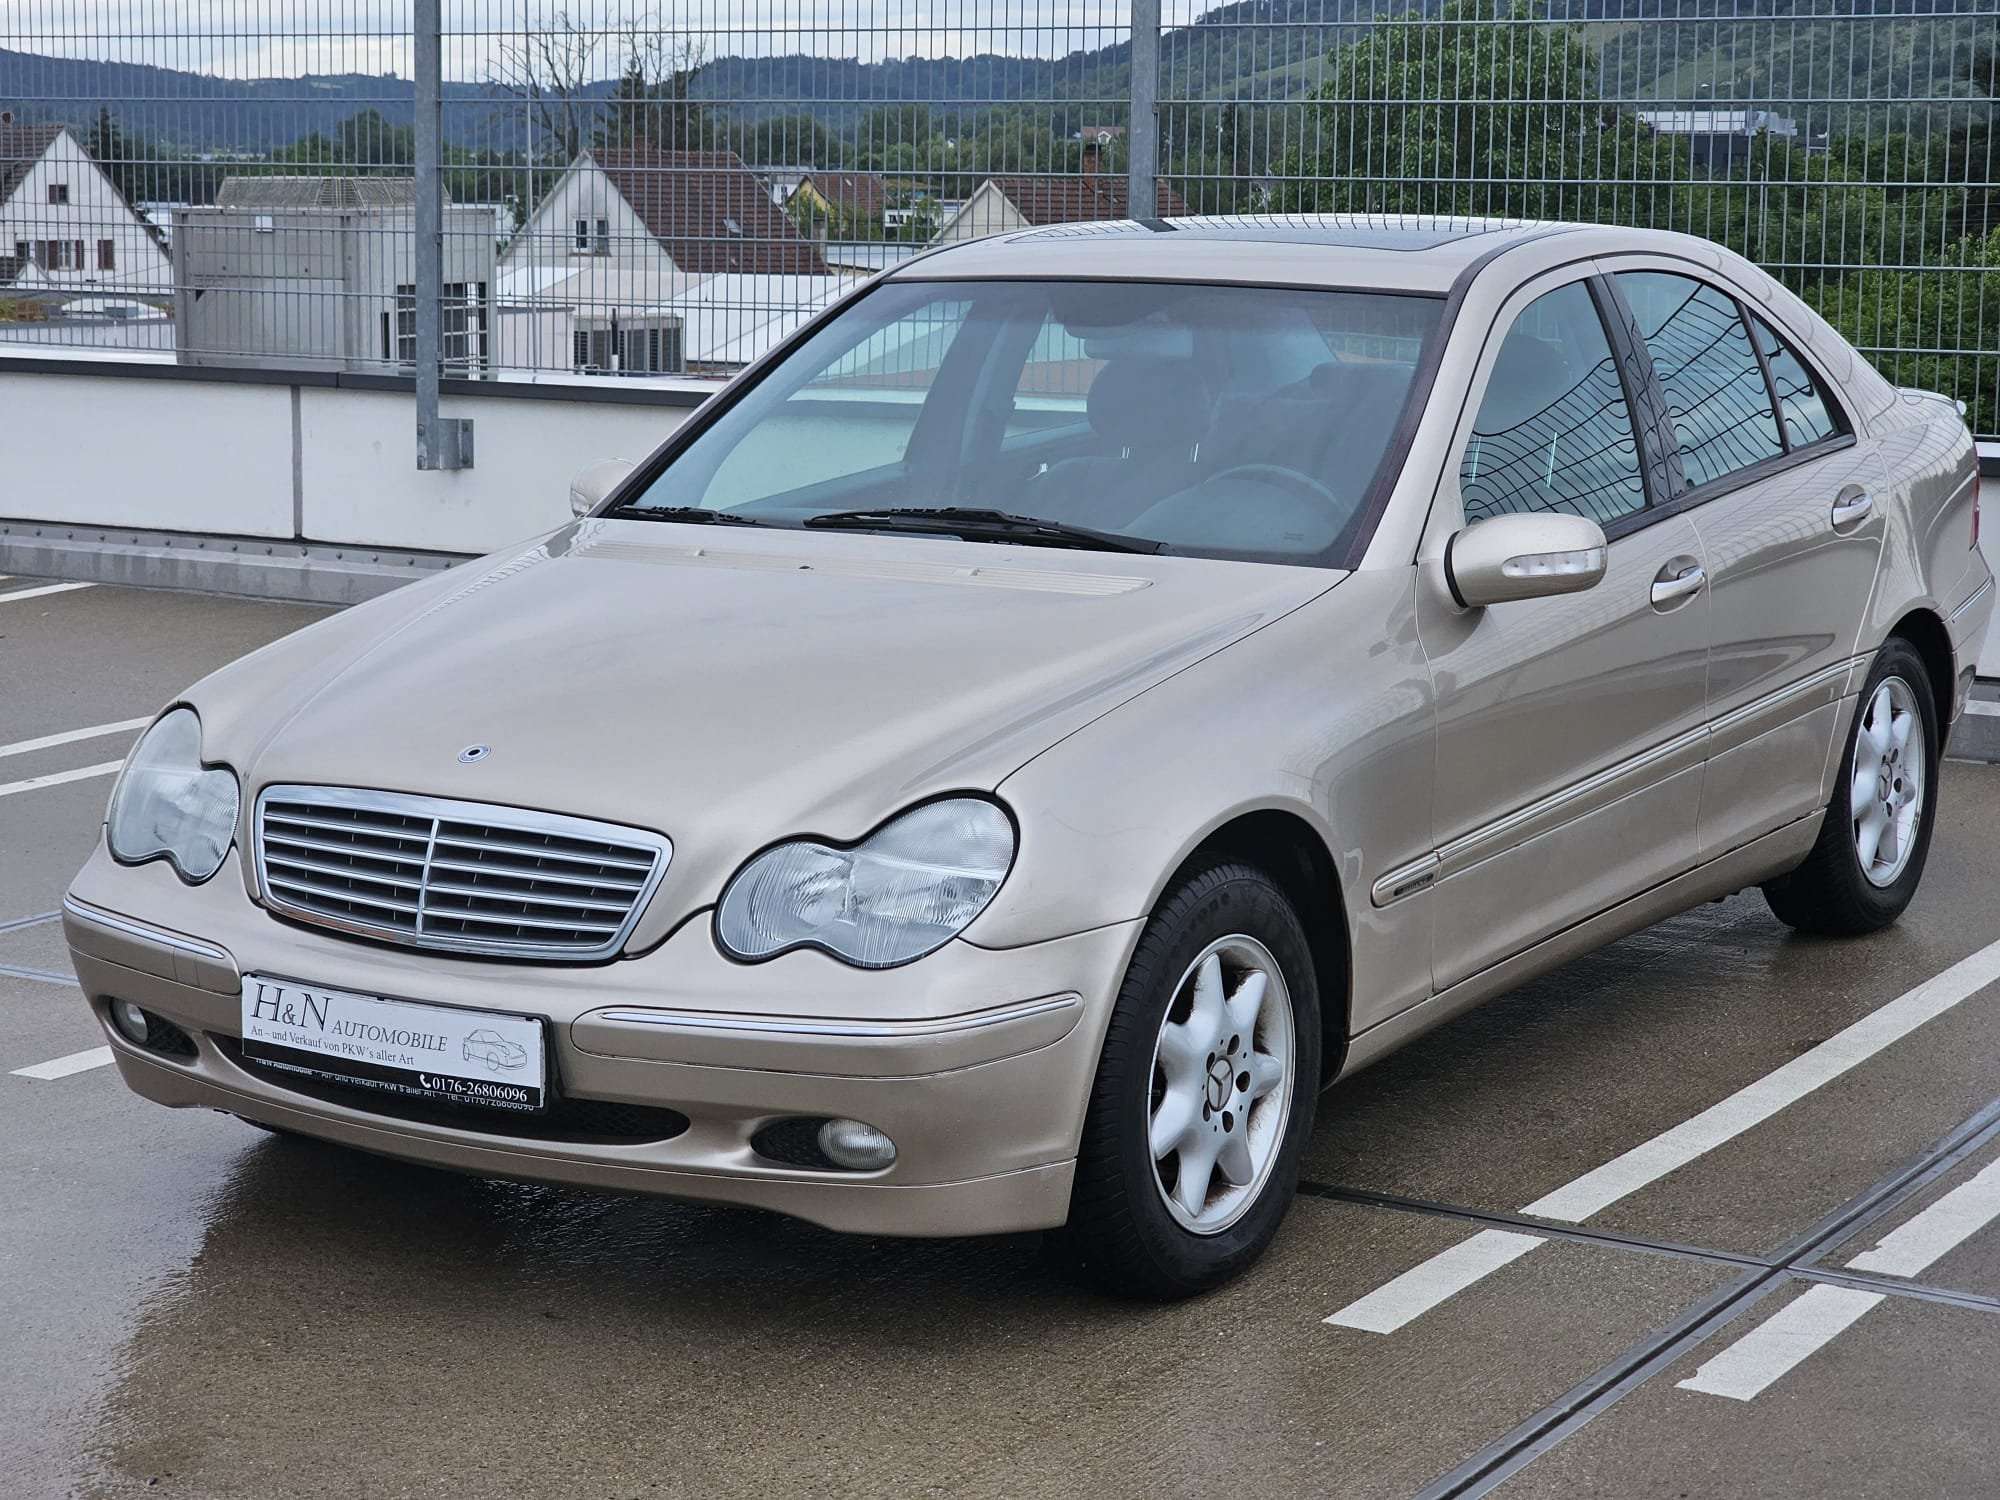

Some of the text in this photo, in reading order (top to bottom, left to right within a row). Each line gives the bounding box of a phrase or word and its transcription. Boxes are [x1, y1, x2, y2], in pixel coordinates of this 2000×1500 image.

[249, 982, 448, 1052] H&N AUTOMOBILE
[251, 1025, 263, 1037] An
[272, 1030, 287, 1041] und
[289, 1031, 322, 1049] Verkauf
[323, 1040, 340, 1052] von
[376, 1049, 397, 1063] aller
[399, 1051, 415, 1066] Art
[432, 1077, 528, 1102] 0176-26806096
